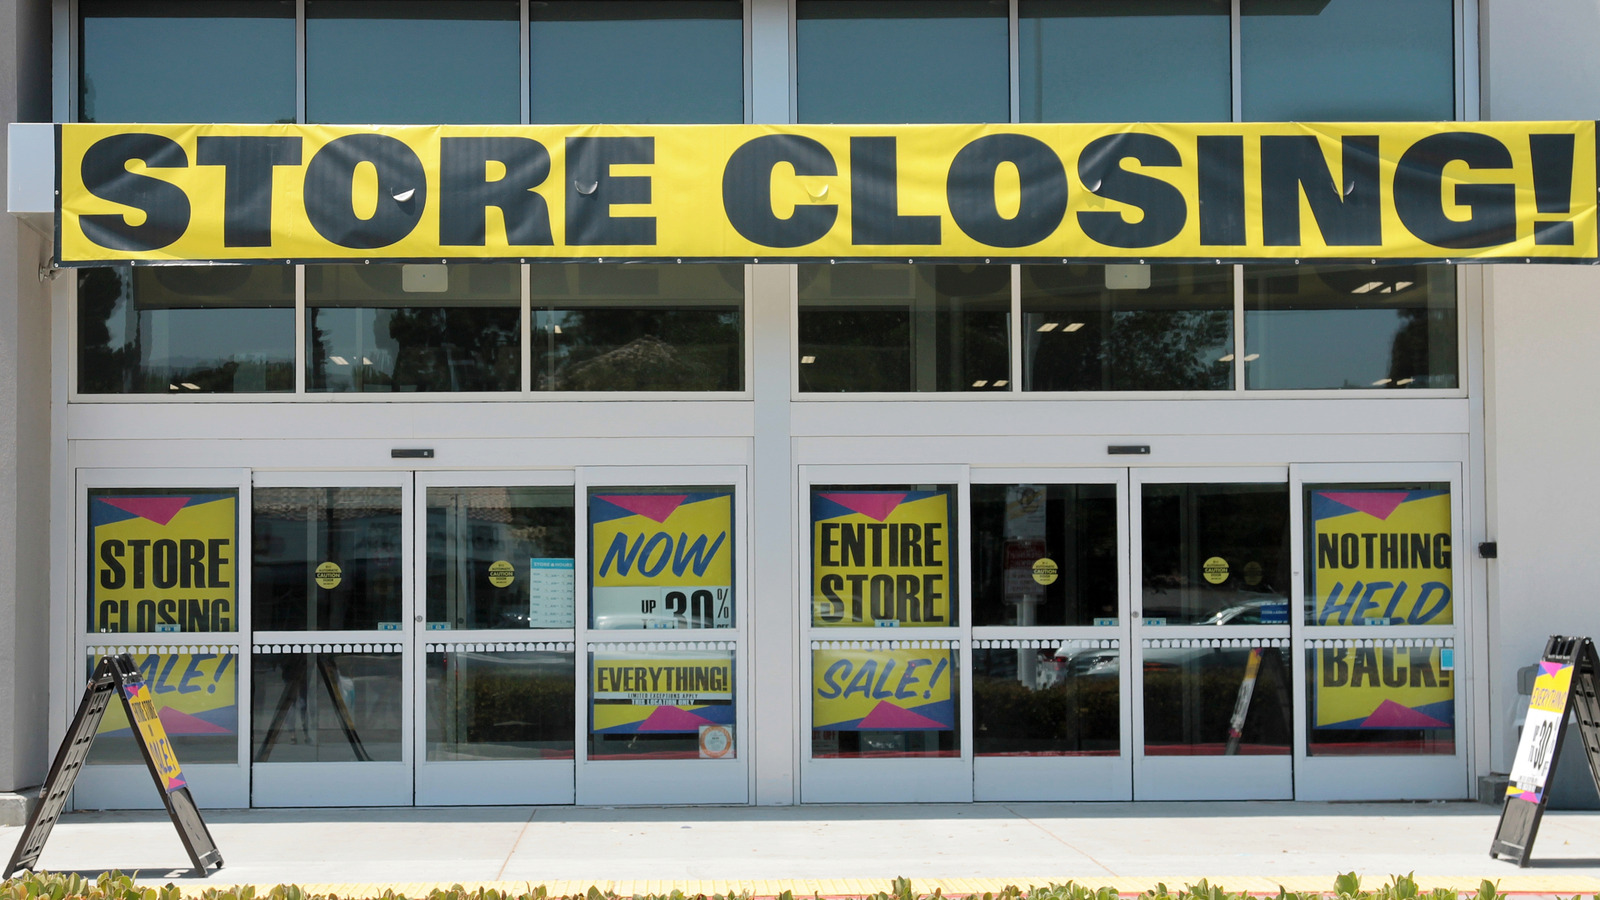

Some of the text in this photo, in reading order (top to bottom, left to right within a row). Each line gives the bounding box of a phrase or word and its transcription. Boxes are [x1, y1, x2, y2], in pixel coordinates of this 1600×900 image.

[78, 131, 1576, 251] STORE CLOSING!
[100, 538, 230, 589] STORE
[598, 530, 726, 578] NOW
[820, 522, 943, 567] ENTIRE
[1318, 532, 1452, 569] NOTHING
[641, 599, 656, 614] UP
[820, 573, 944, 623] STORE
[1318, 580, 1452, 626] HELD
[113, 653, 234, 695] ALE!
[597, 666, 728, 692] EVERYTHING!
[817, 657, 948, 700] SALE!
